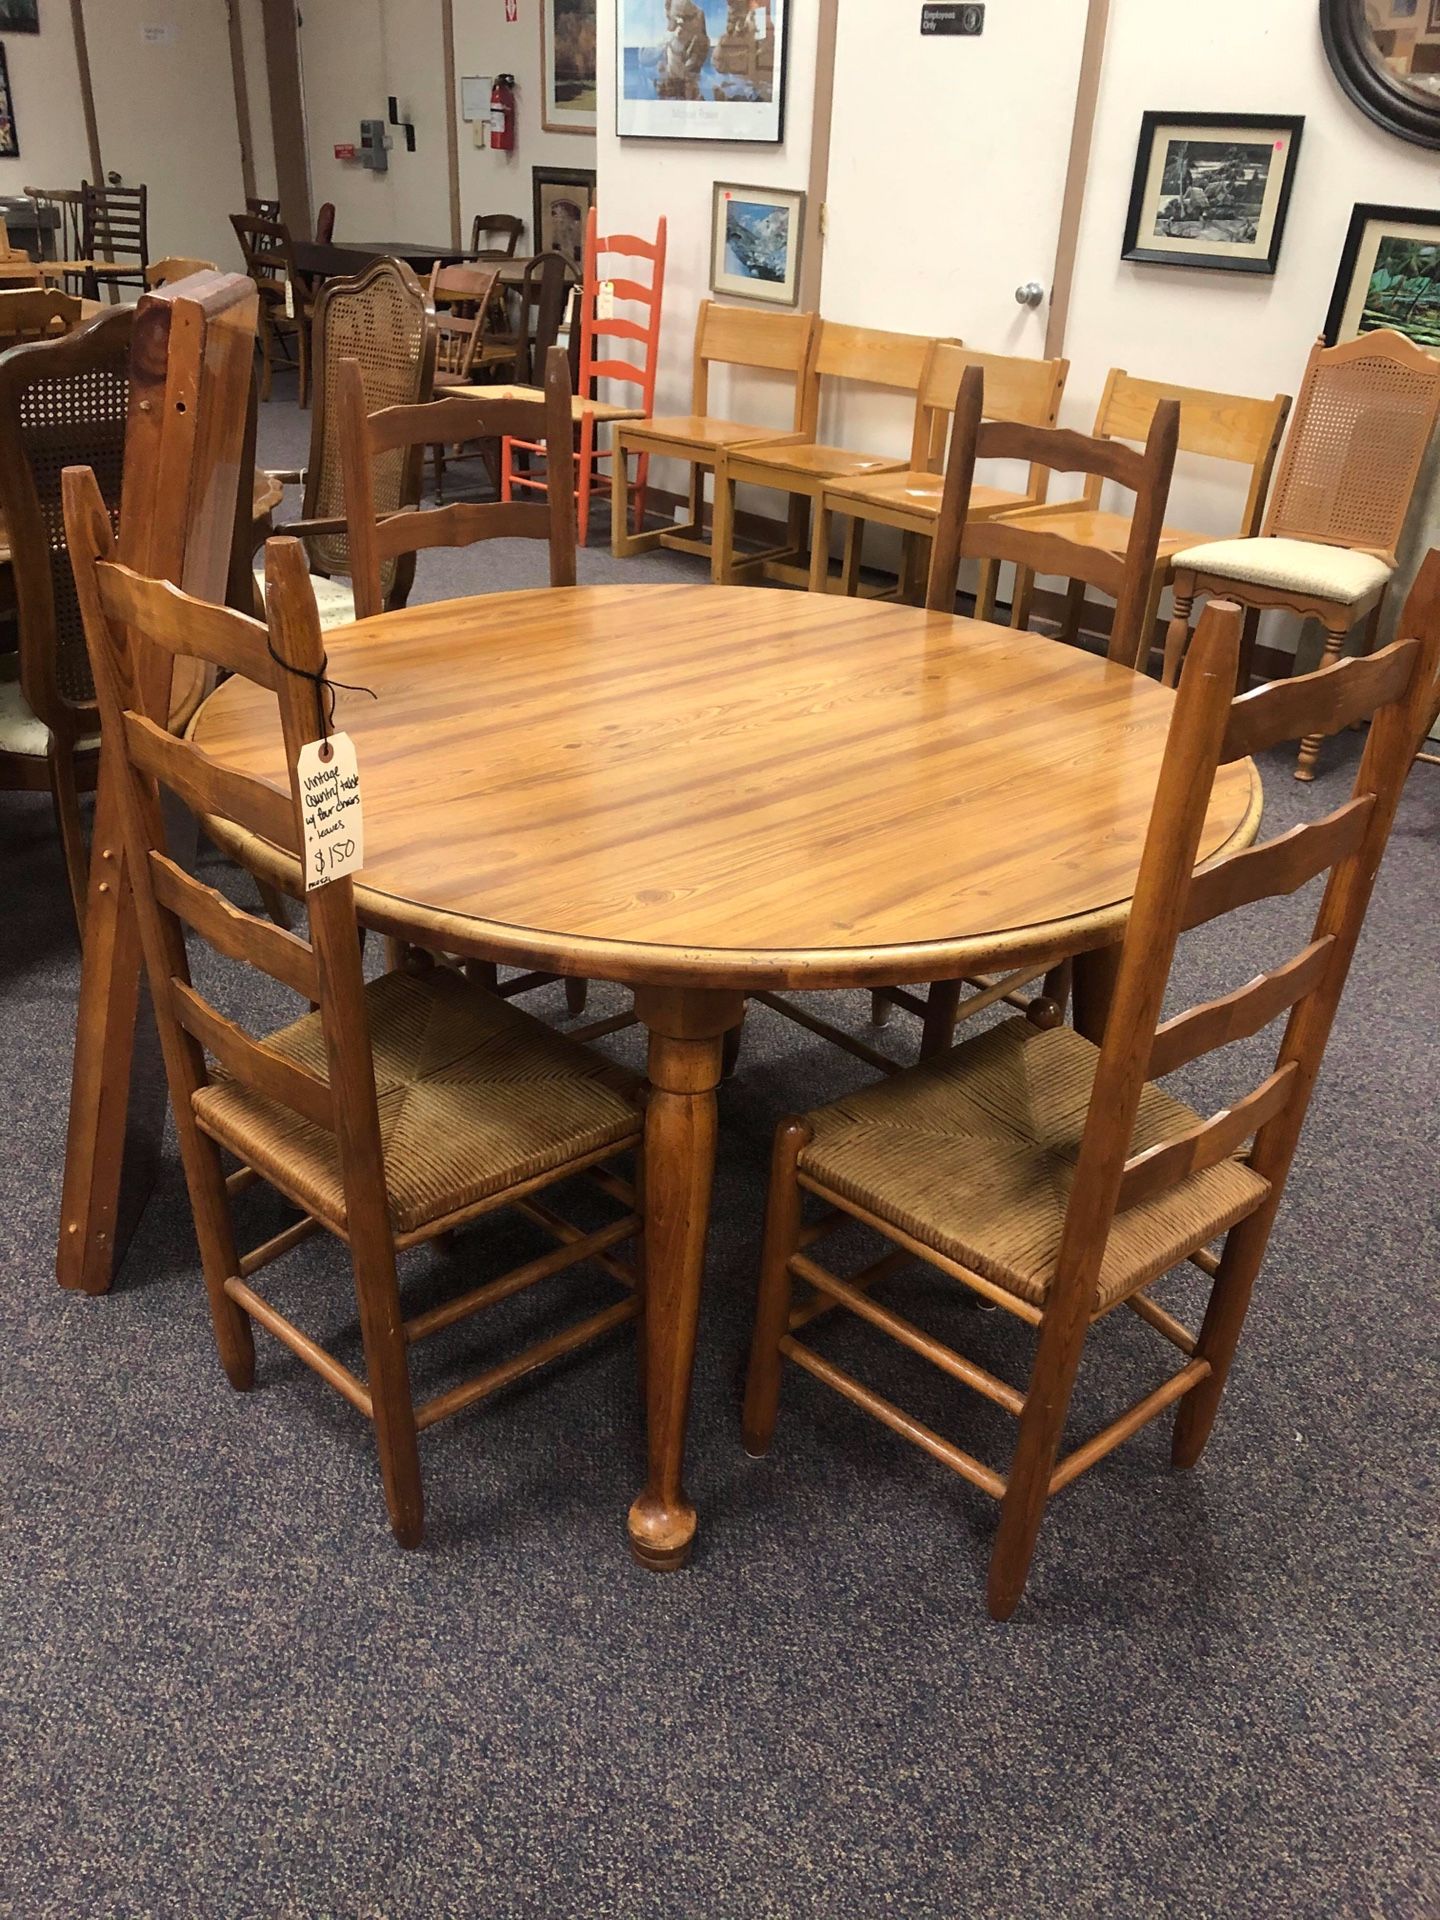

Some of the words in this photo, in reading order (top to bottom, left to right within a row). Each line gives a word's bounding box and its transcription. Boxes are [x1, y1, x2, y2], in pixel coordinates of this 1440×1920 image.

[923, 10, 956, 20] Employees
[922, 20, 937, 31] Only
[304, 766, 340, 791] Vintage
[340, 775, 360, 792] table
[317, 805, 334, 822] four
[314, 839, 355, 875] $150
